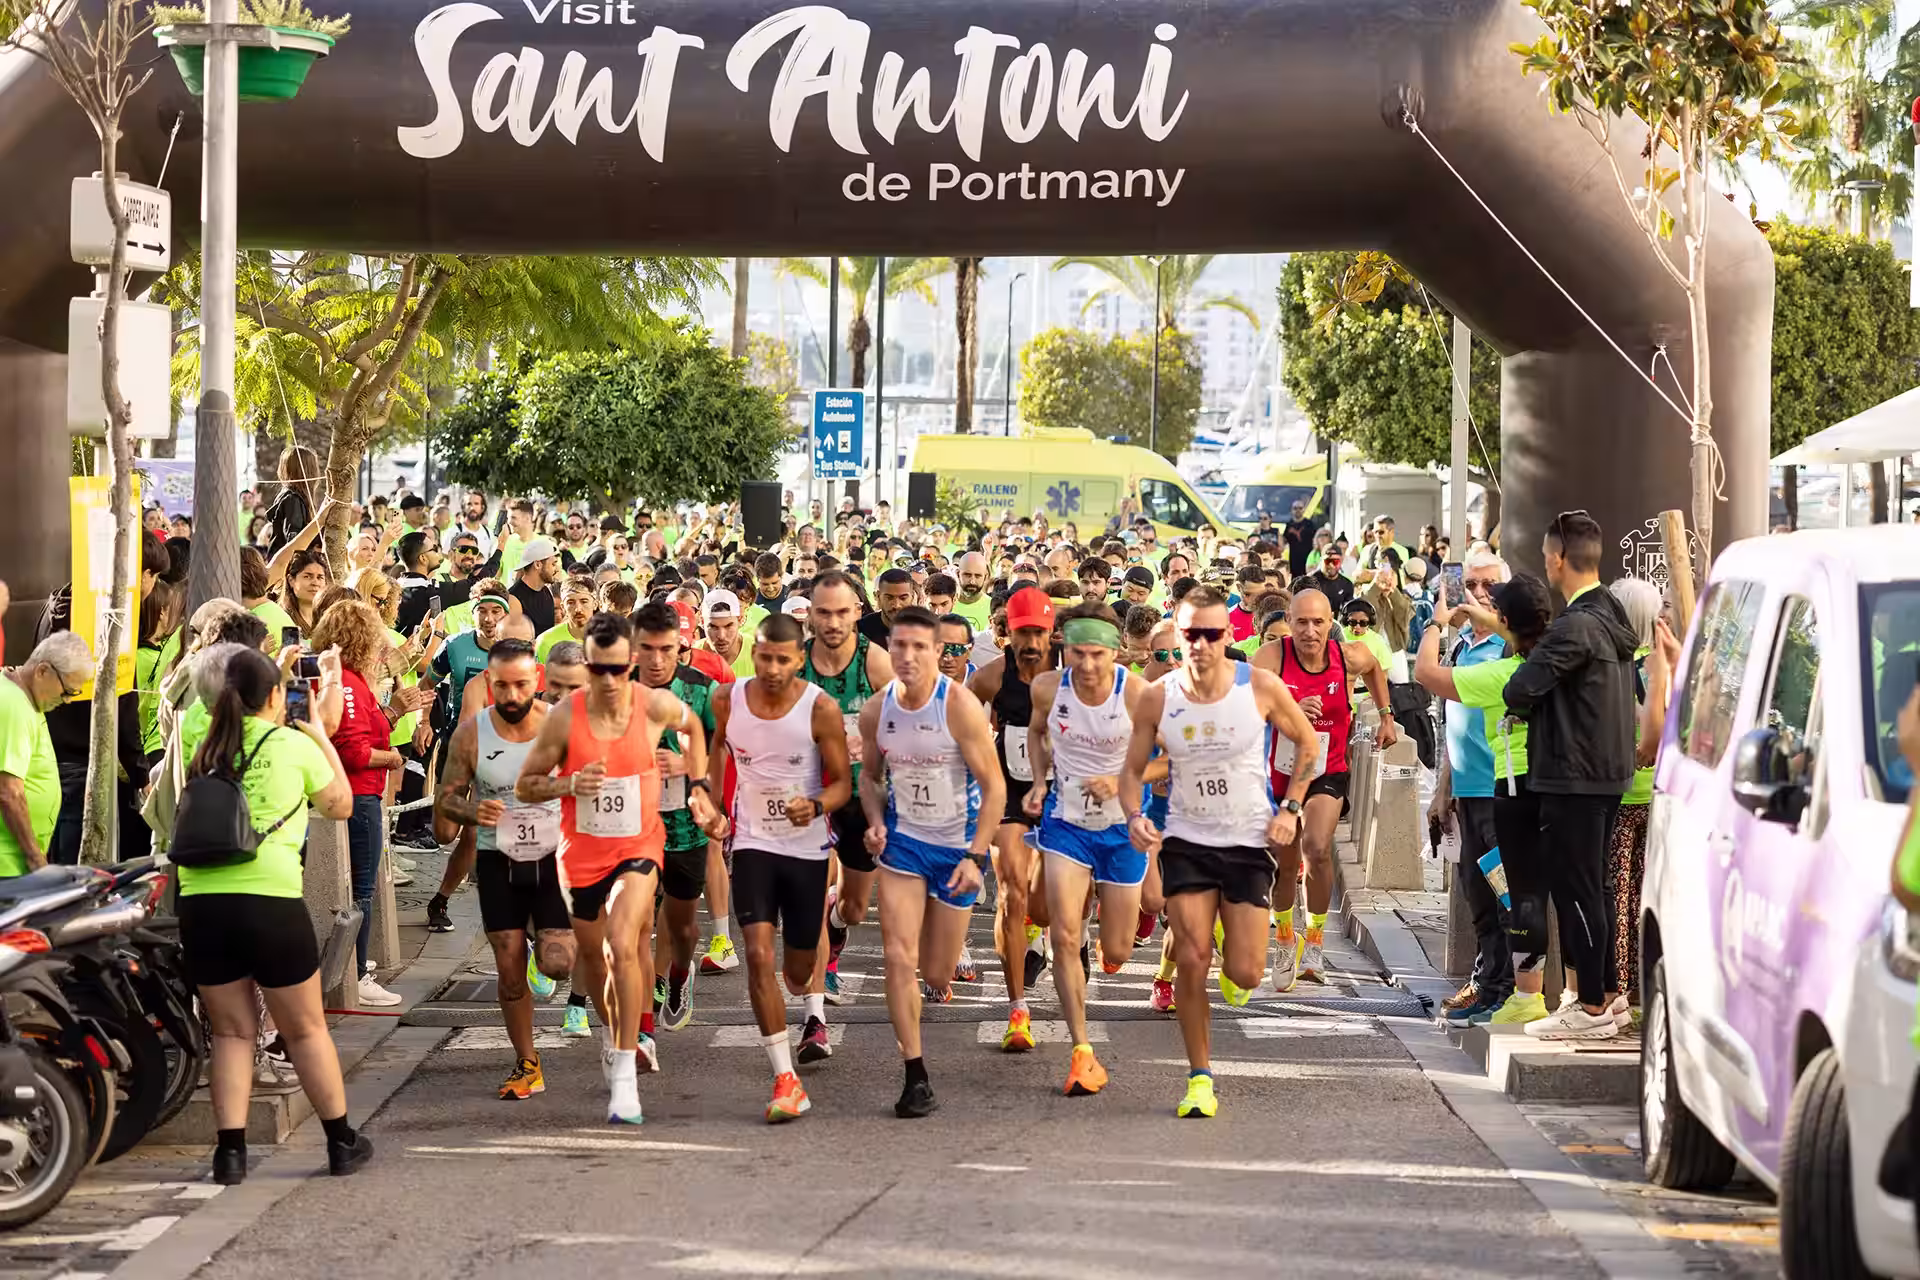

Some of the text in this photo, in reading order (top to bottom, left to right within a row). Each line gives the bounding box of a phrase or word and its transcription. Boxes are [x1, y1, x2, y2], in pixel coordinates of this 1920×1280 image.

[522, 0, 637, 25] Visit
[397, 2, 1189, 163] Sant Antoni
[842, 162, 1186, 207] de Portmany
[976, 498, 1015, 508] CLINIC
[1312, 719, 1334, 727] ROUP
[911, 784, 931, 801] 71
[1195, 778, 1229, 798] 188
[591, 795, 625, 813] 139
[766, 799, 788, 817] 86
[516, 823, 536, 841] 31
